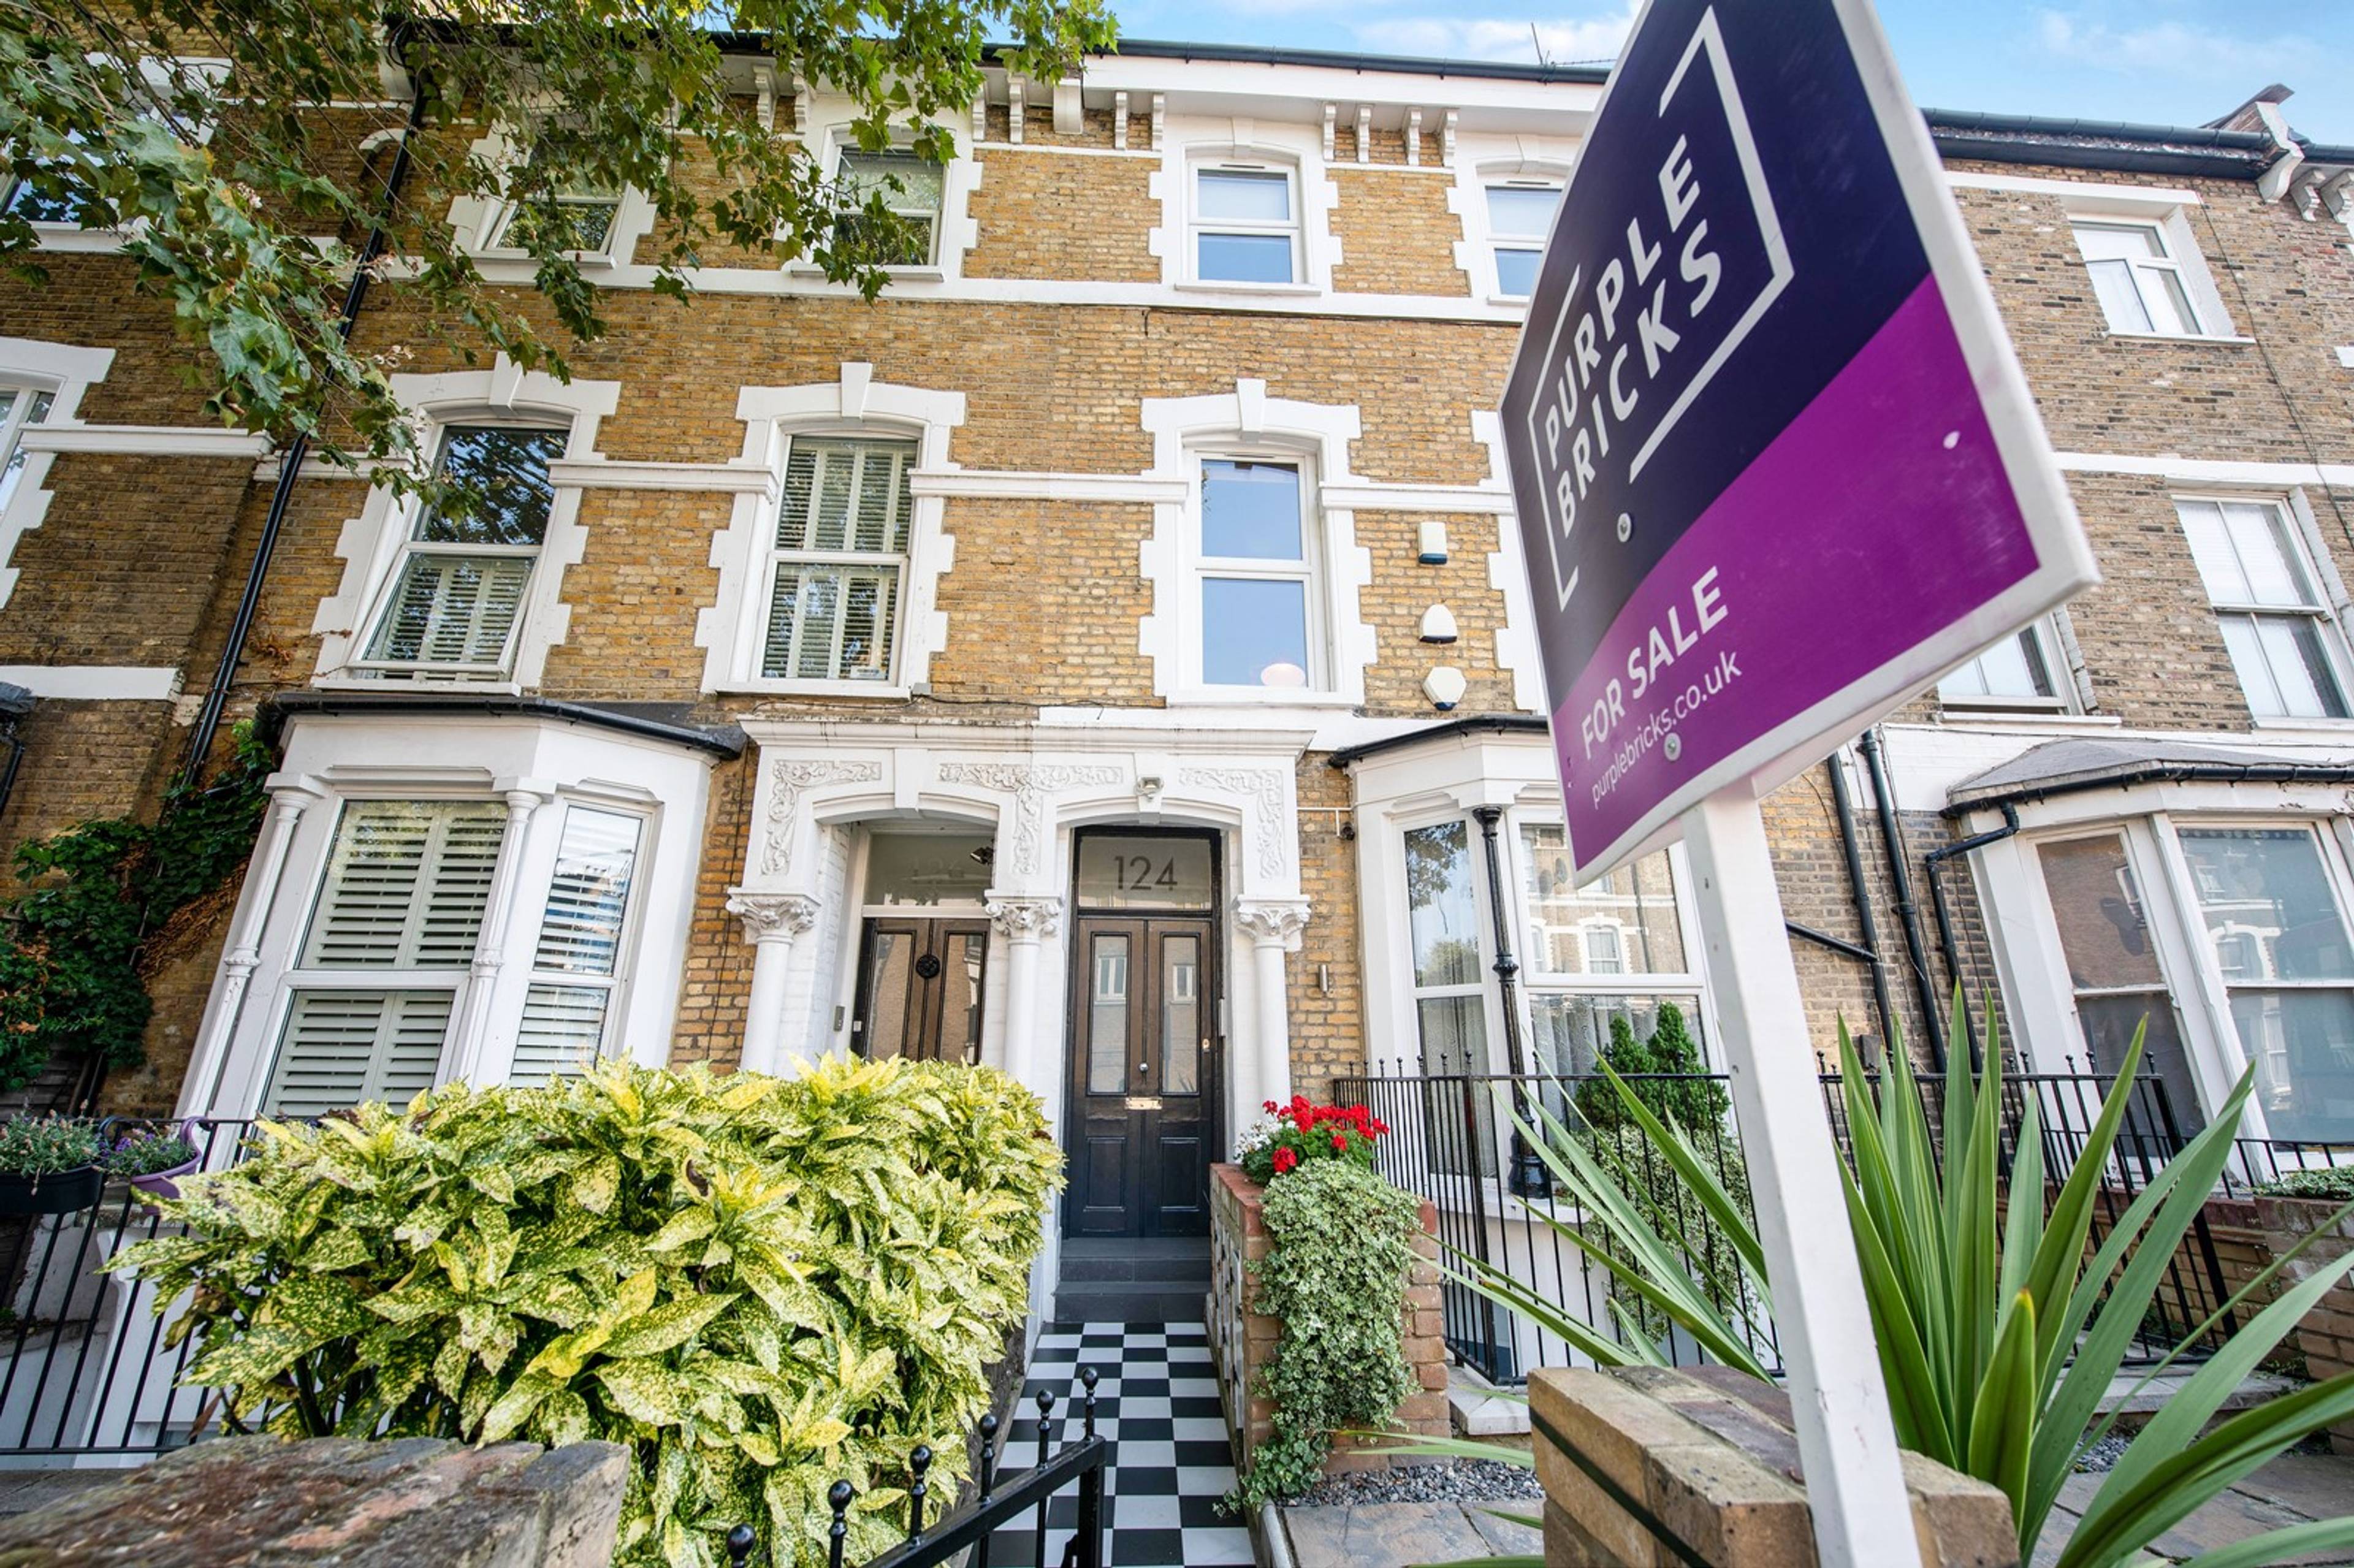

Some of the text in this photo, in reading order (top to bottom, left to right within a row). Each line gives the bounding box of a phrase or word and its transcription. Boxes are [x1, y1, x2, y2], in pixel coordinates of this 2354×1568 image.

[1545, 134, 1701, 471] PURPLE
[1557, 218, 1721, 538] BRICKS
[1581, 566, 1729, 759] FOR SALE
[1592, 650, 1742, 810] purplebricks.co.uk
[1114, 855, 1178, 891] 124
